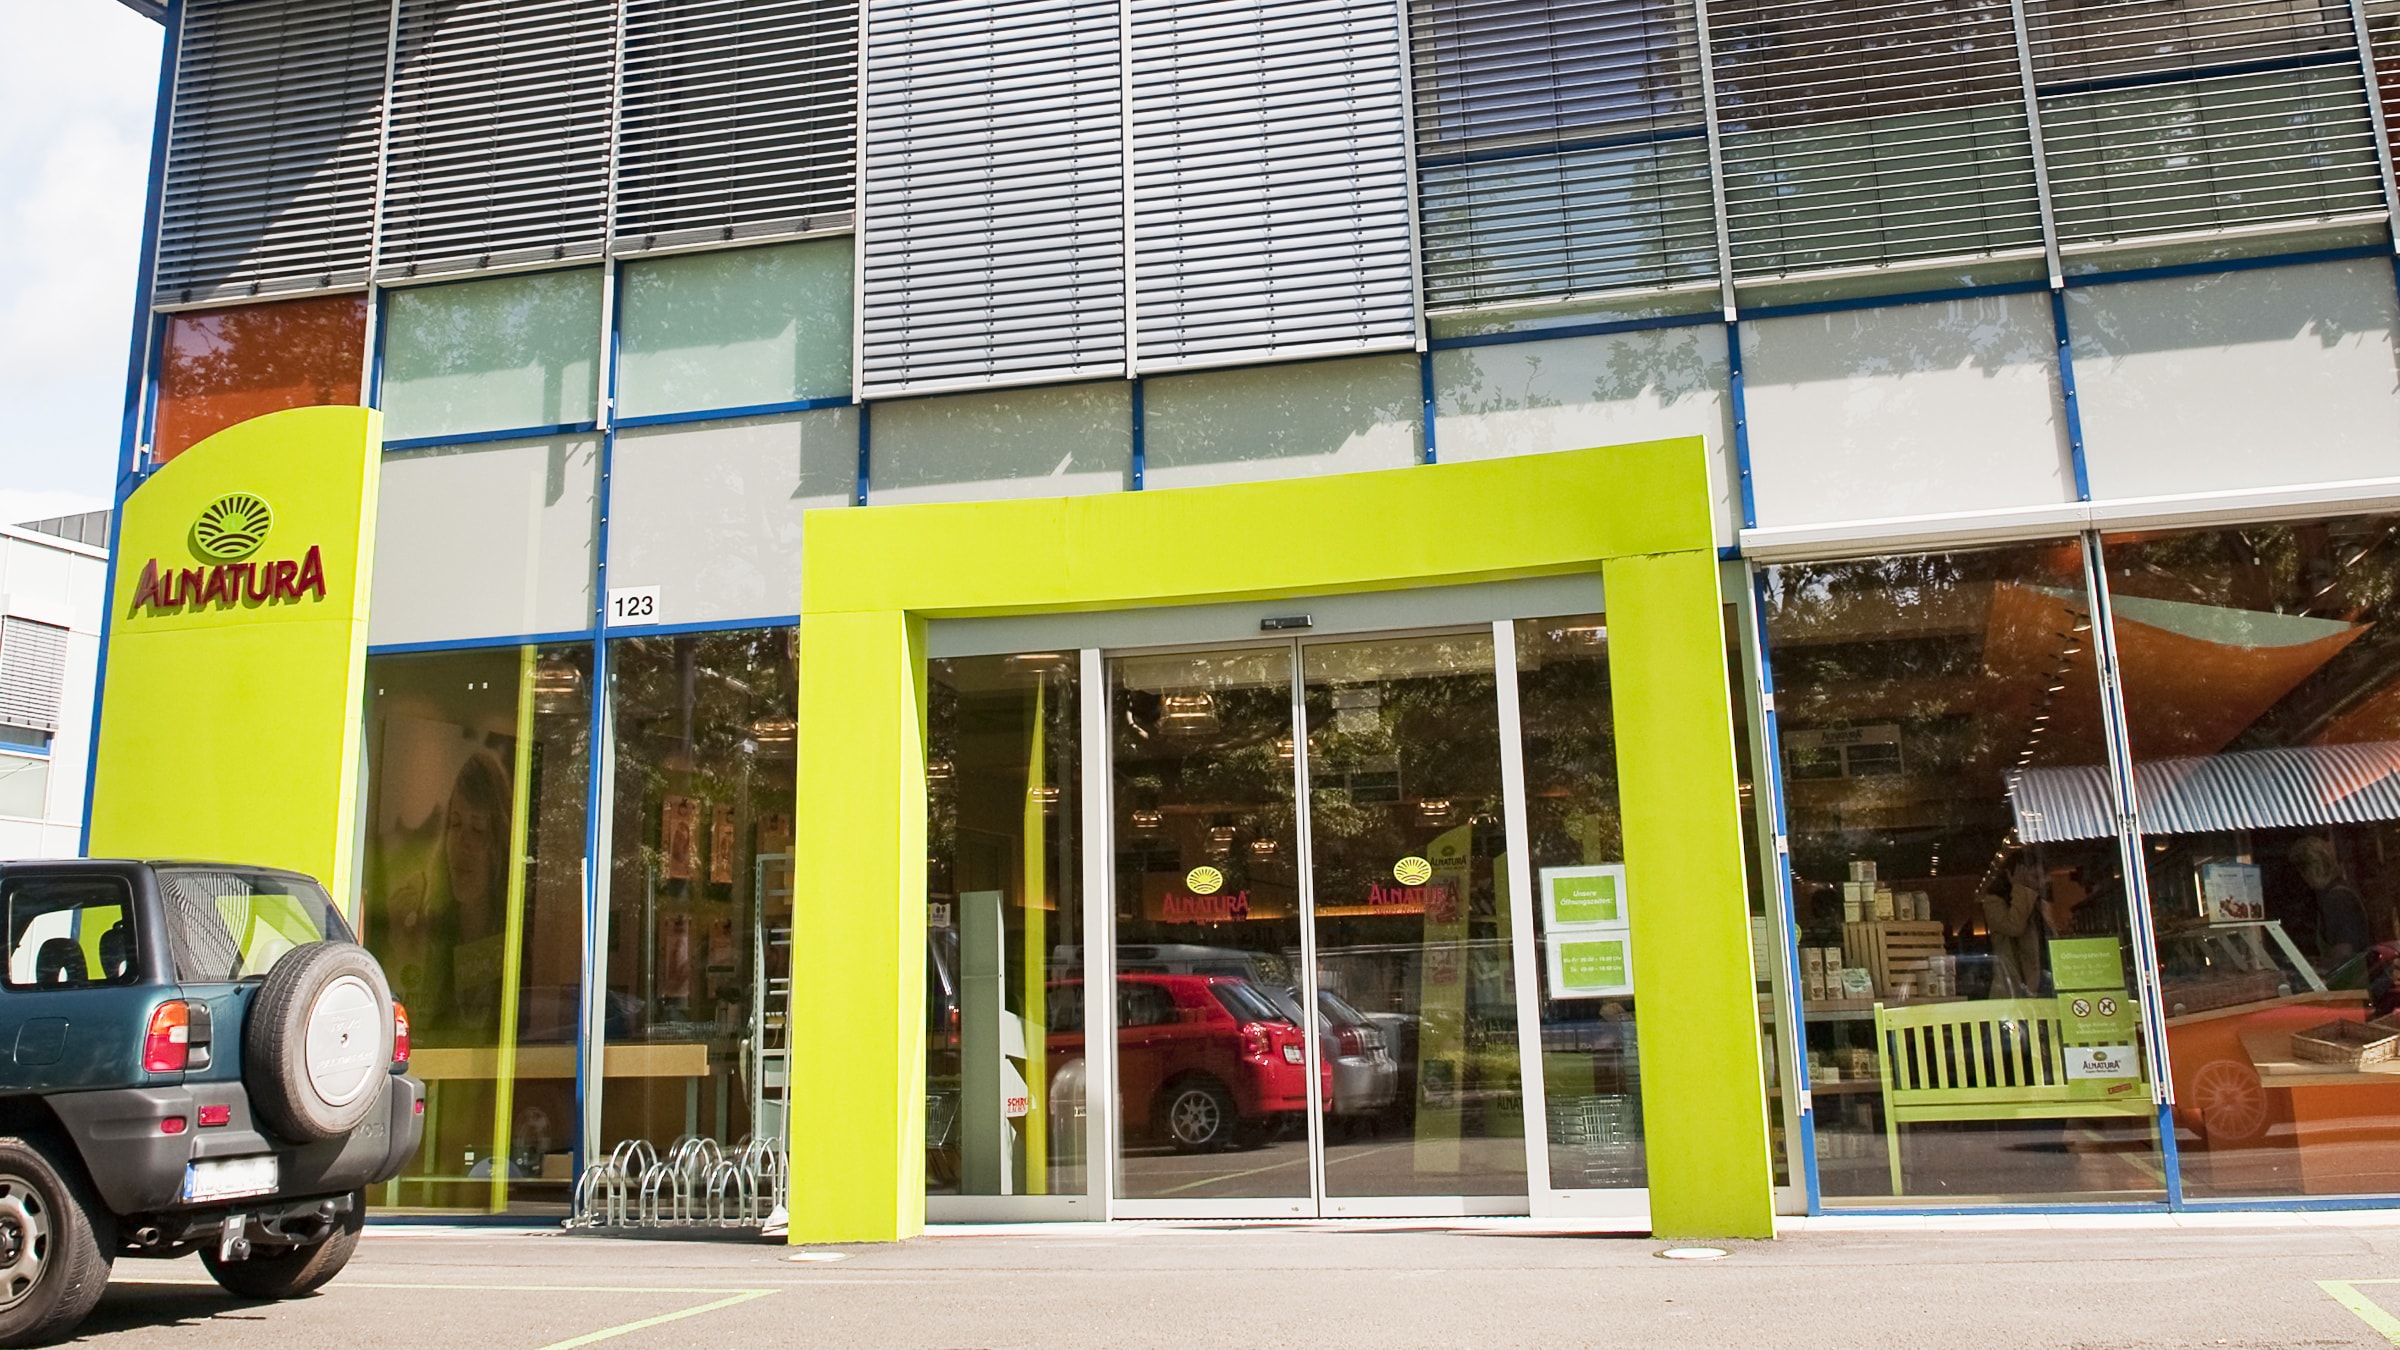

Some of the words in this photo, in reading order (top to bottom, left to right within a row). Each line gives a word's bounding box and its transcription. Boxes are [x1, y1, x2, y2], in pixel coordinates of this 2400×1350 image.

[134, 545, 327, 609] ALNATURA
[615, 595, 653, 617] 123
[1162, 890, 1249, 914] ALNATURA
[1368, 881, 1460, 905] ALNATURA
[1572, 890, 1597, 898] Unsere
[2083, 1060, 2120, 1070] ALNATURA
[350, 1122, 386, 1140] OYOTA
